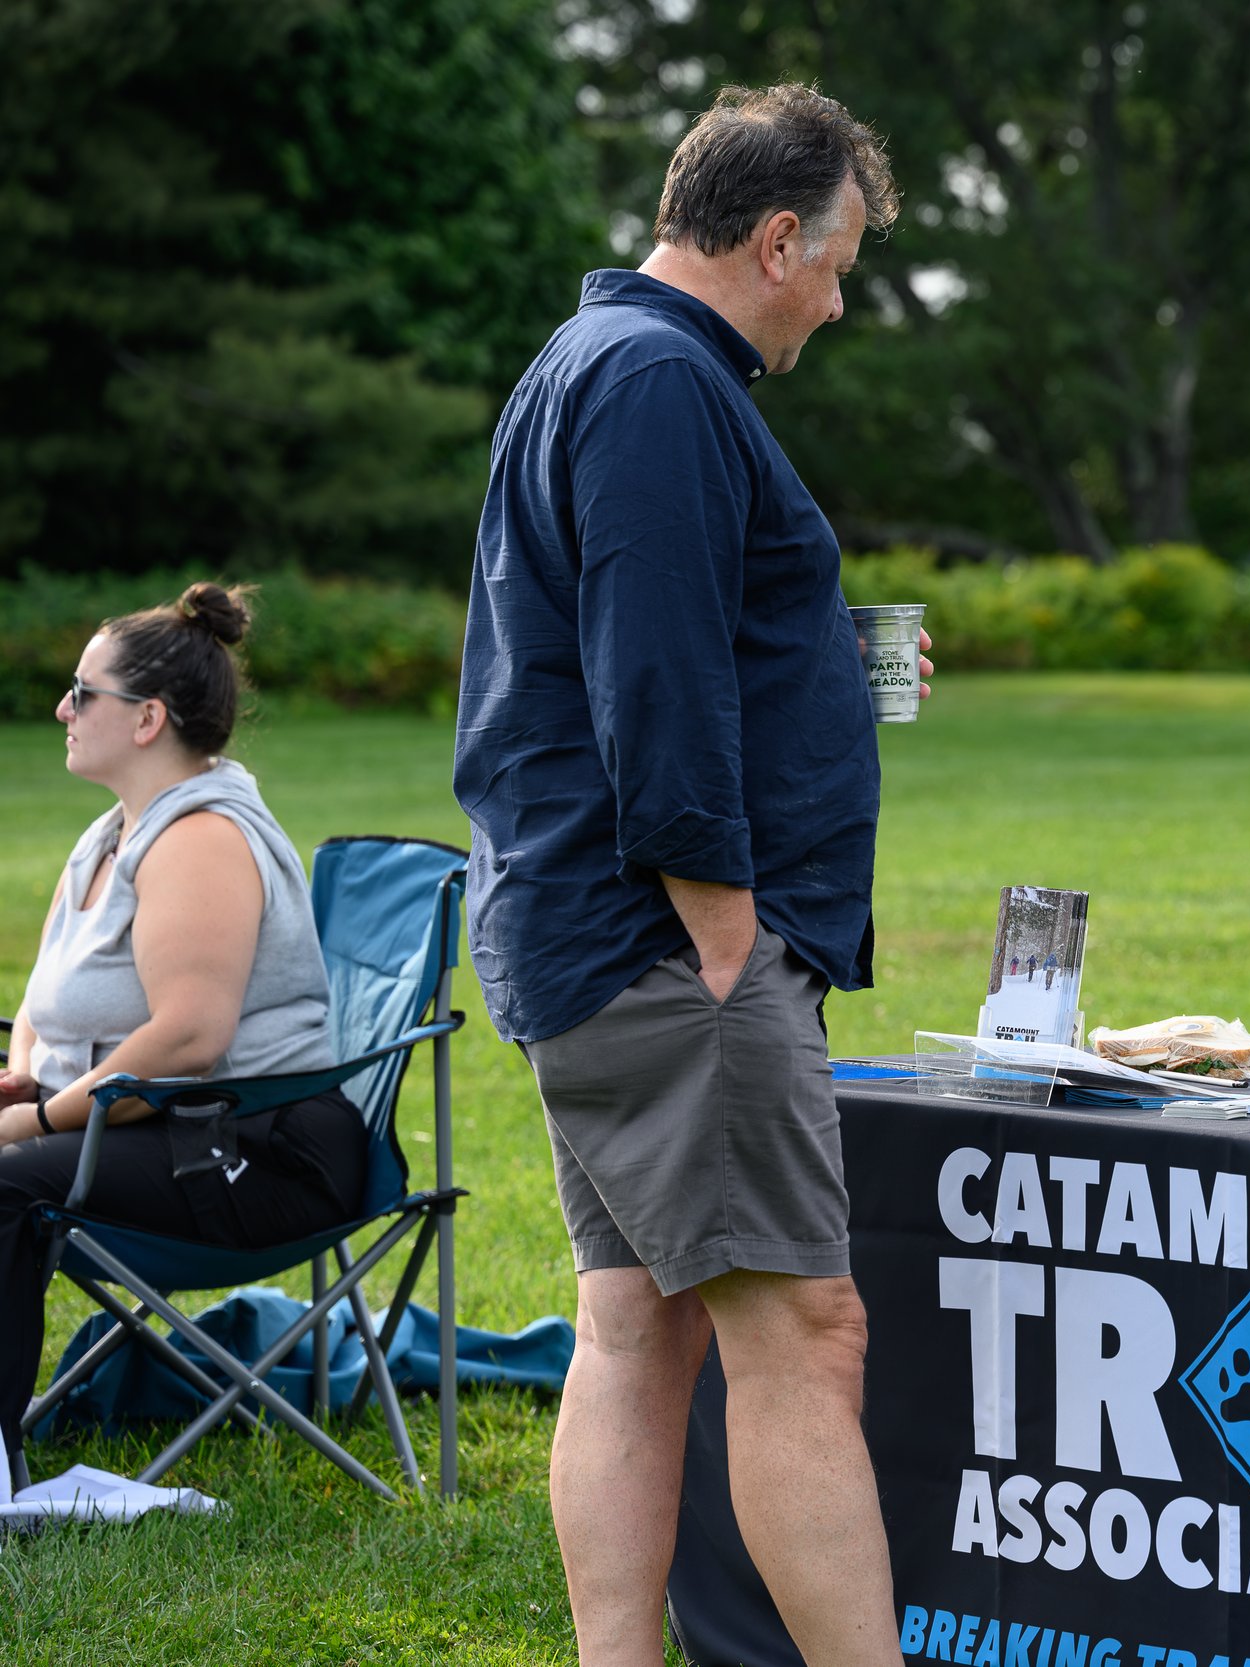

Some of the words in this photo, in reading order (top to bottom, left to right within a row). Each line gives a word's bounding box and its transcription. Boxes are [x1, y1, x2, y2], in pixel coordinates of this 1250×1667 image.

[870, 662, 910, 672] PARTY
[996, 1026, 1040, 1036] CATAMOUNT
[900, 1605, 1123, 1667] BREAKING
